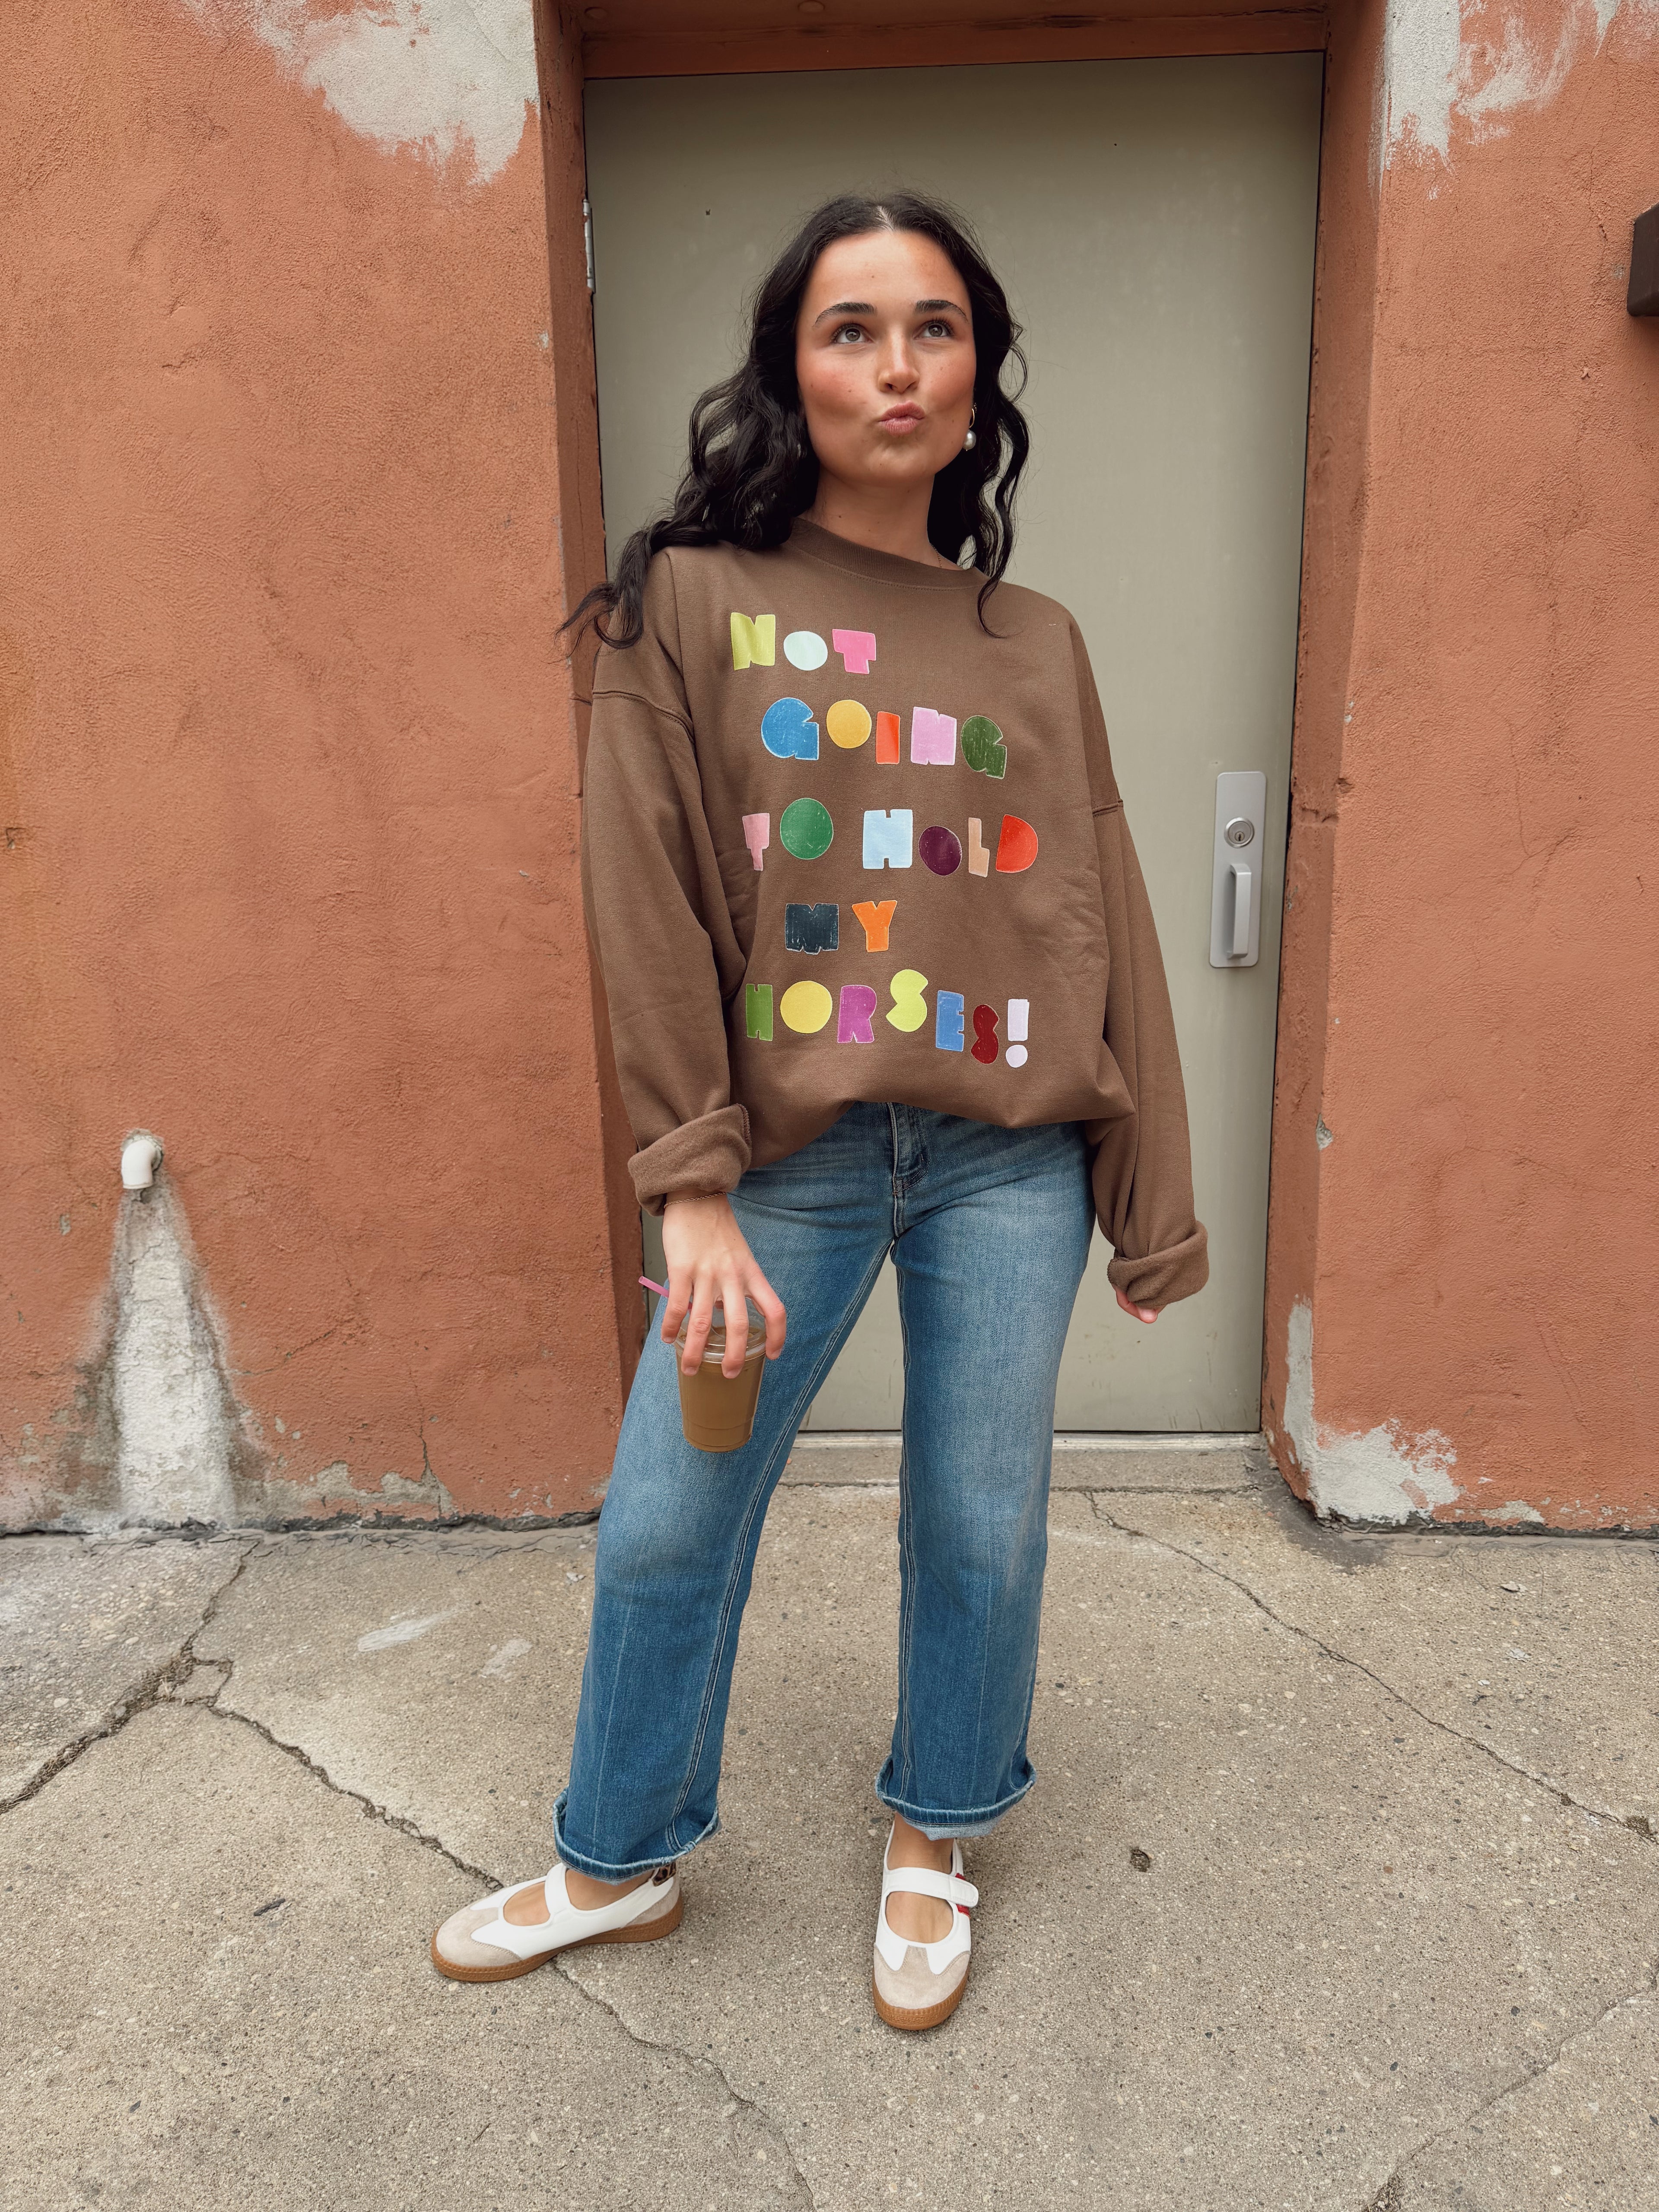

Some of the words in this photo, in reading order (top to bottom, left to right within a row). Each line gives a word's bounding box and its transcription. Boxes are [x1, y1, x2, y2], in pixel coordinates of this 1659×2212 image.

[730, 612, 877, 674] NOT
[761, 697, 1007, 779] GOING
[742, 797, 834, 872] TO
[862, 808, 1039, 878] HOLD
[784, 899, 898, 955] MY
[745, 969, 1030, 1068] HORSES!
